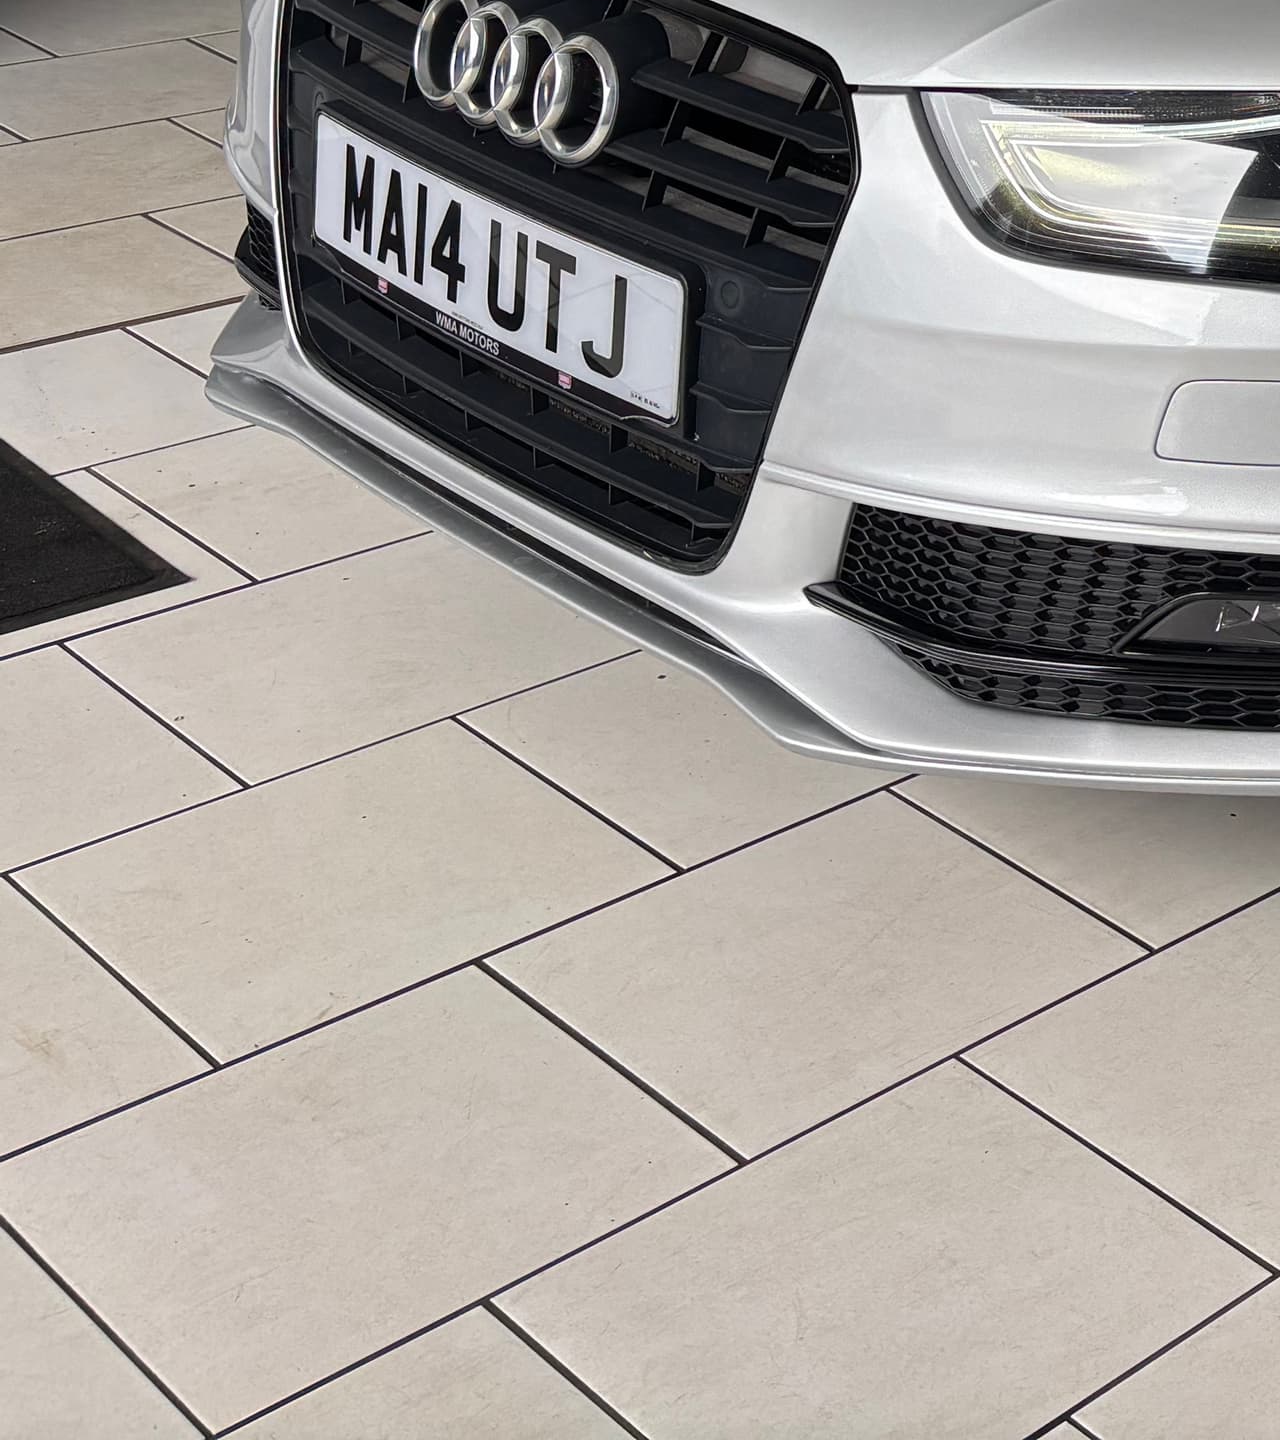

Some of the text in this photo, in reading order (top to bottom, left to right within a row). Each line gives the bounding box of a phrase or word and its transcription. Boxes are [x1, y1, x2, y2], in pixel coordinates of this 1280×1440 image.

[343, 143, 628, 379] MA14 UTJ
[434, 311, 458, 335] WMA
[458, 323, 500, 357] MOTORS
